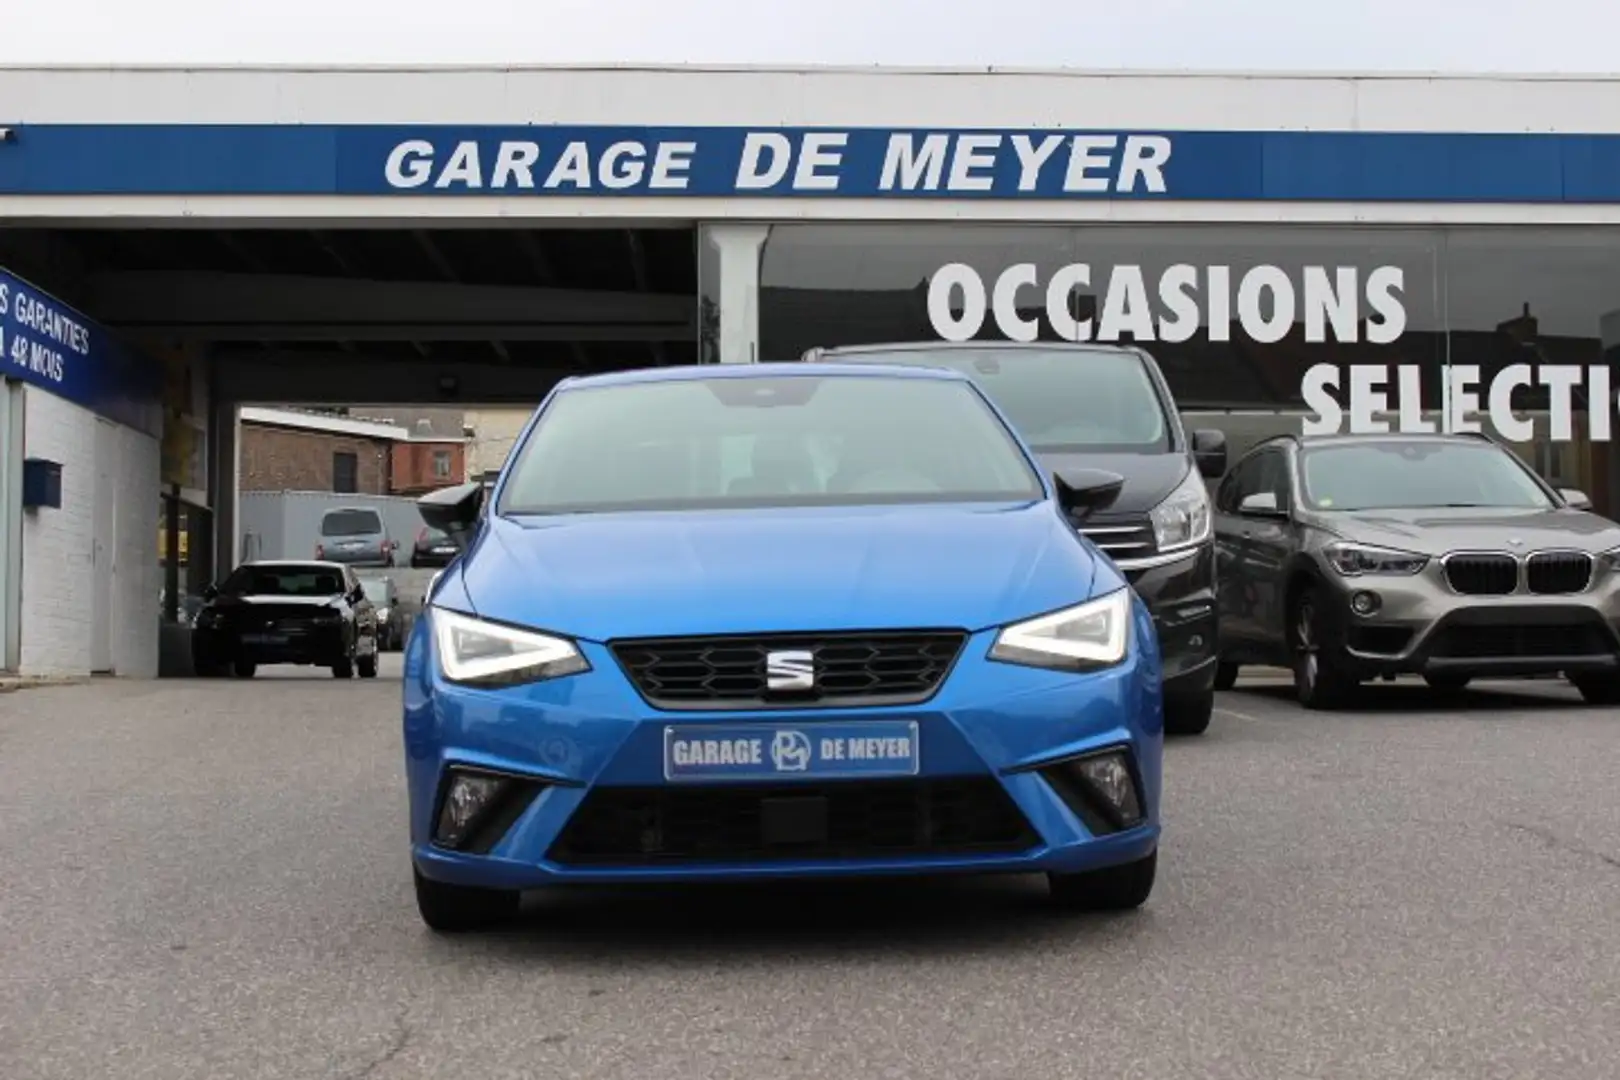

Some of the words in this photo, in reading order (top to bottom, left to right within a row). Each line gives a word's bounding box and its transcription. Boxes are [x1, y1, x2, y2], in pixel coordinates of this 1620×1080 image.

[385, 140, 696, 189] GARAGE
[736, 132, 848, 190] DE
[879, 134, 1171, 194] MEYER
[15, 292, 89, 355] GARANTIES
[927, 263, 1407, 343] OCCASIONS
[11, 335, 29, 367] 48
[30, 342, 64, 382] MOIS
[1302, 363, 1620, 442] SELECTI
[673, 738, 762, 766] GARAGE
[820, 737, 846, 760] DE
[847, 736, 911, 760] MEYER
